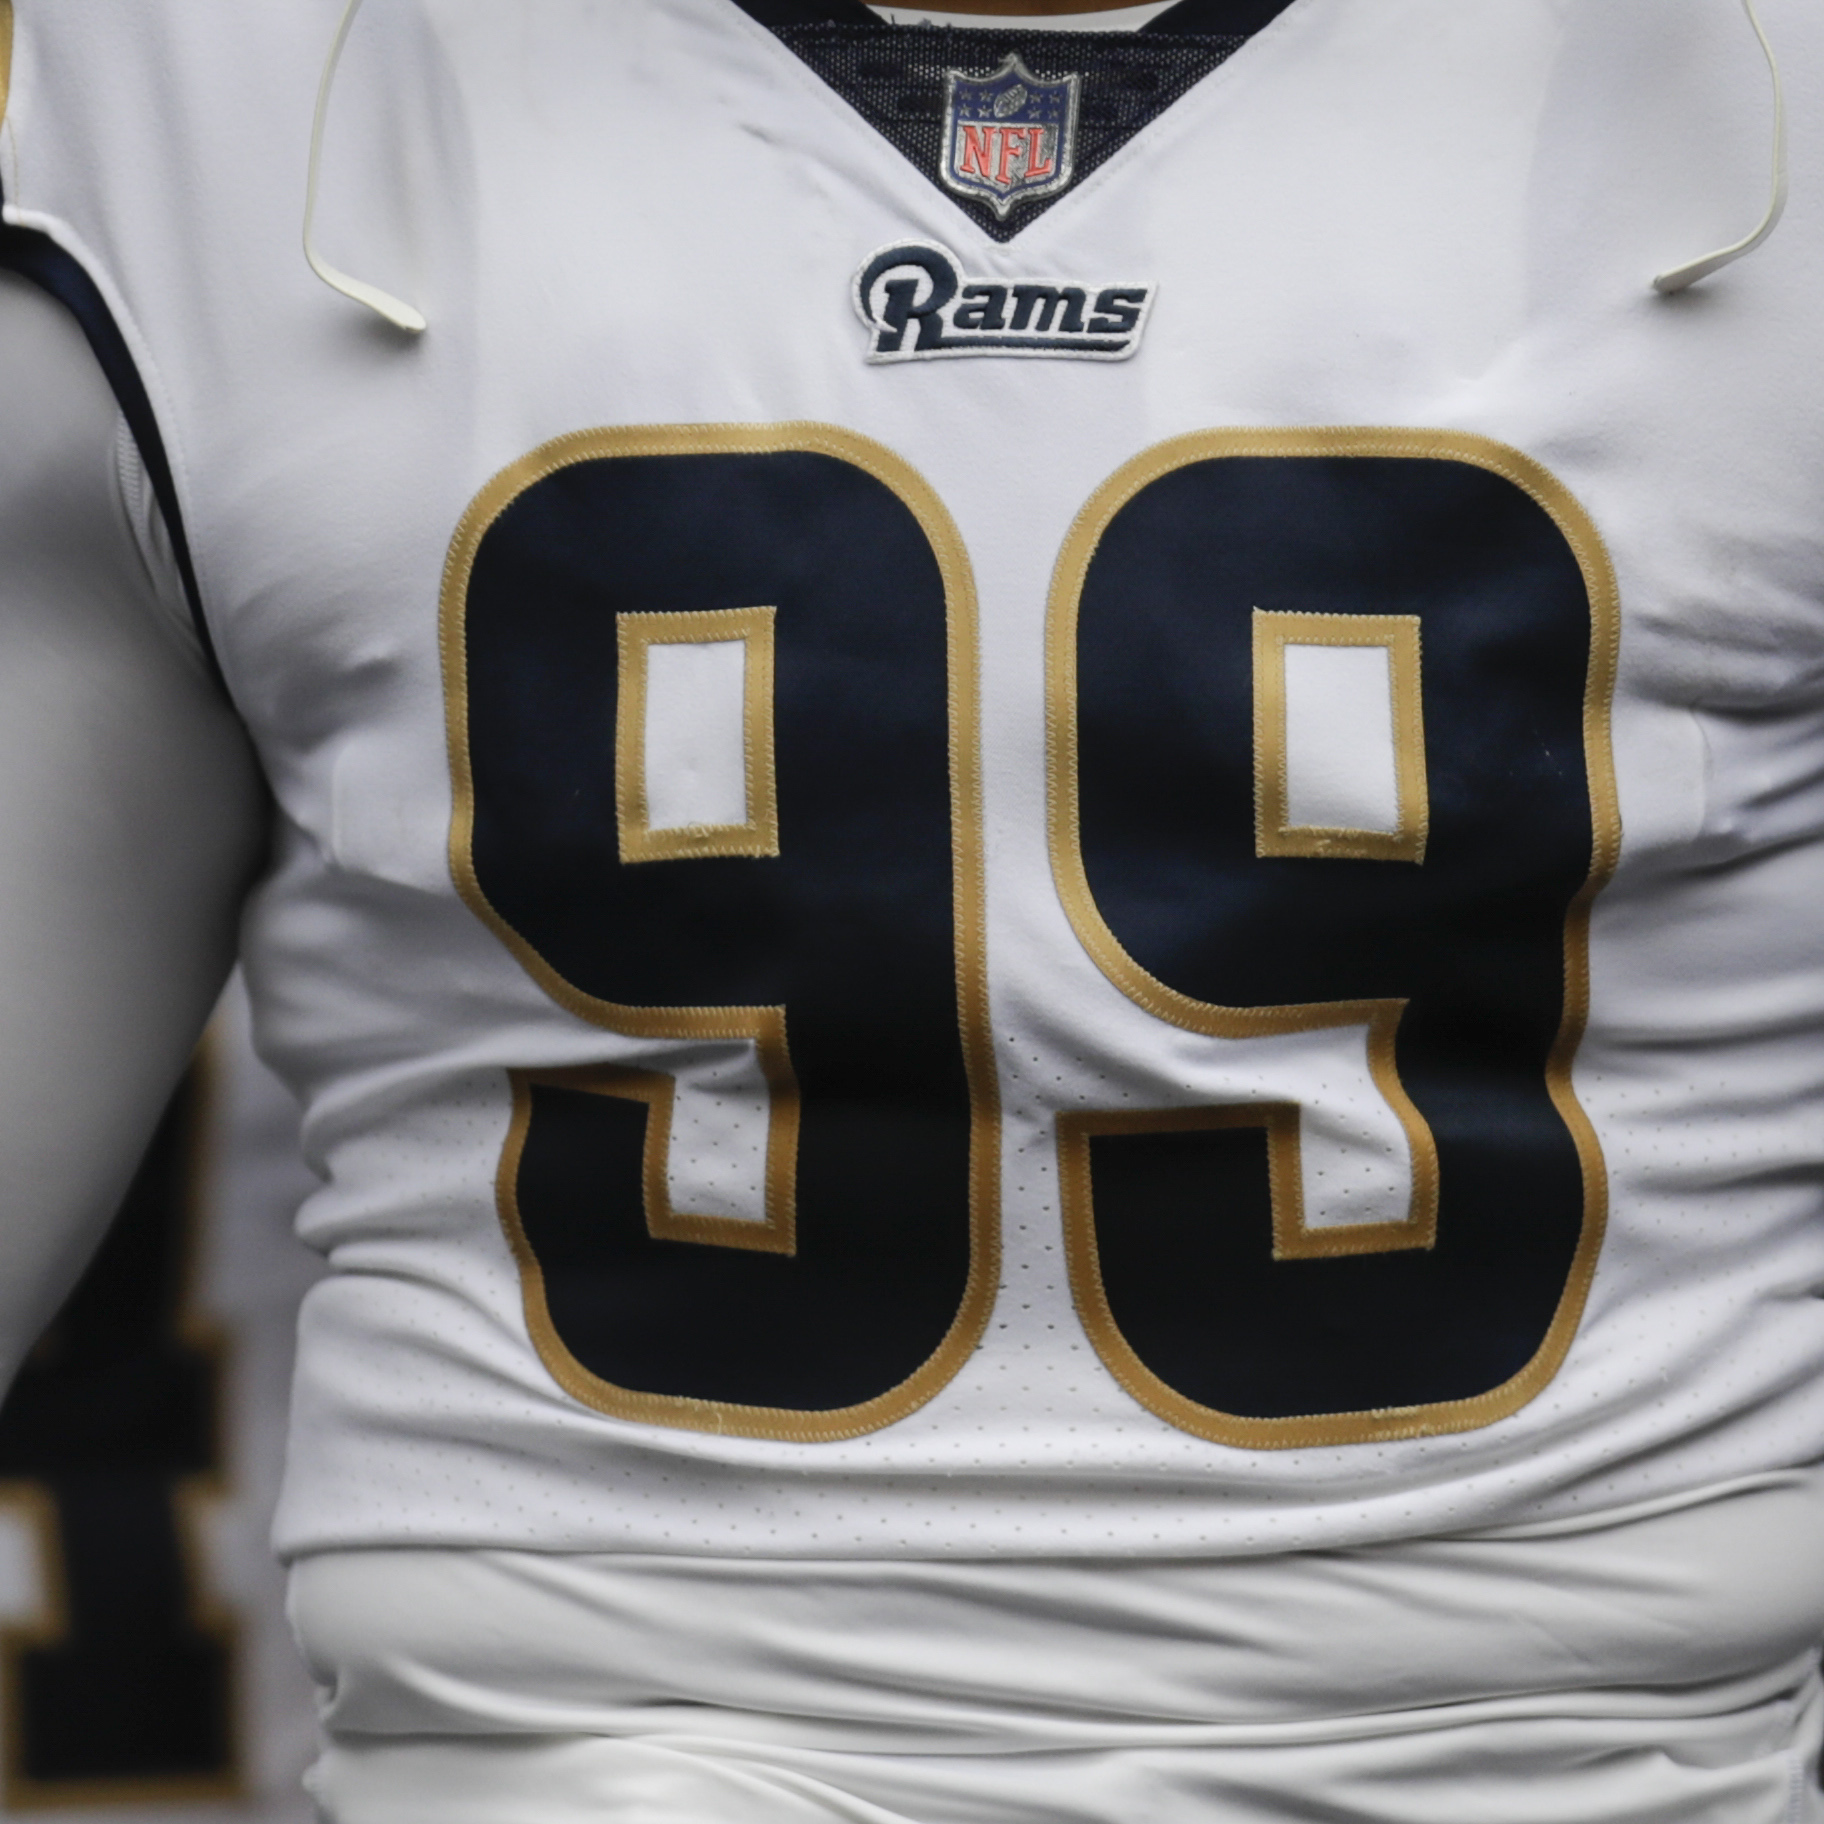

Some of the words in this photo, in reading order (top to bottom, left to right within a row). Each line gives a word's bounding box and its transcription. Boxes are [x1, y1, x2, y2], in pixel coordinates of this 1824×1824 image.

[959, 124, 1053, 186] NFL
[859, 244, 1149, 352] Rams
[438, 421, 1621, 1452] 99
